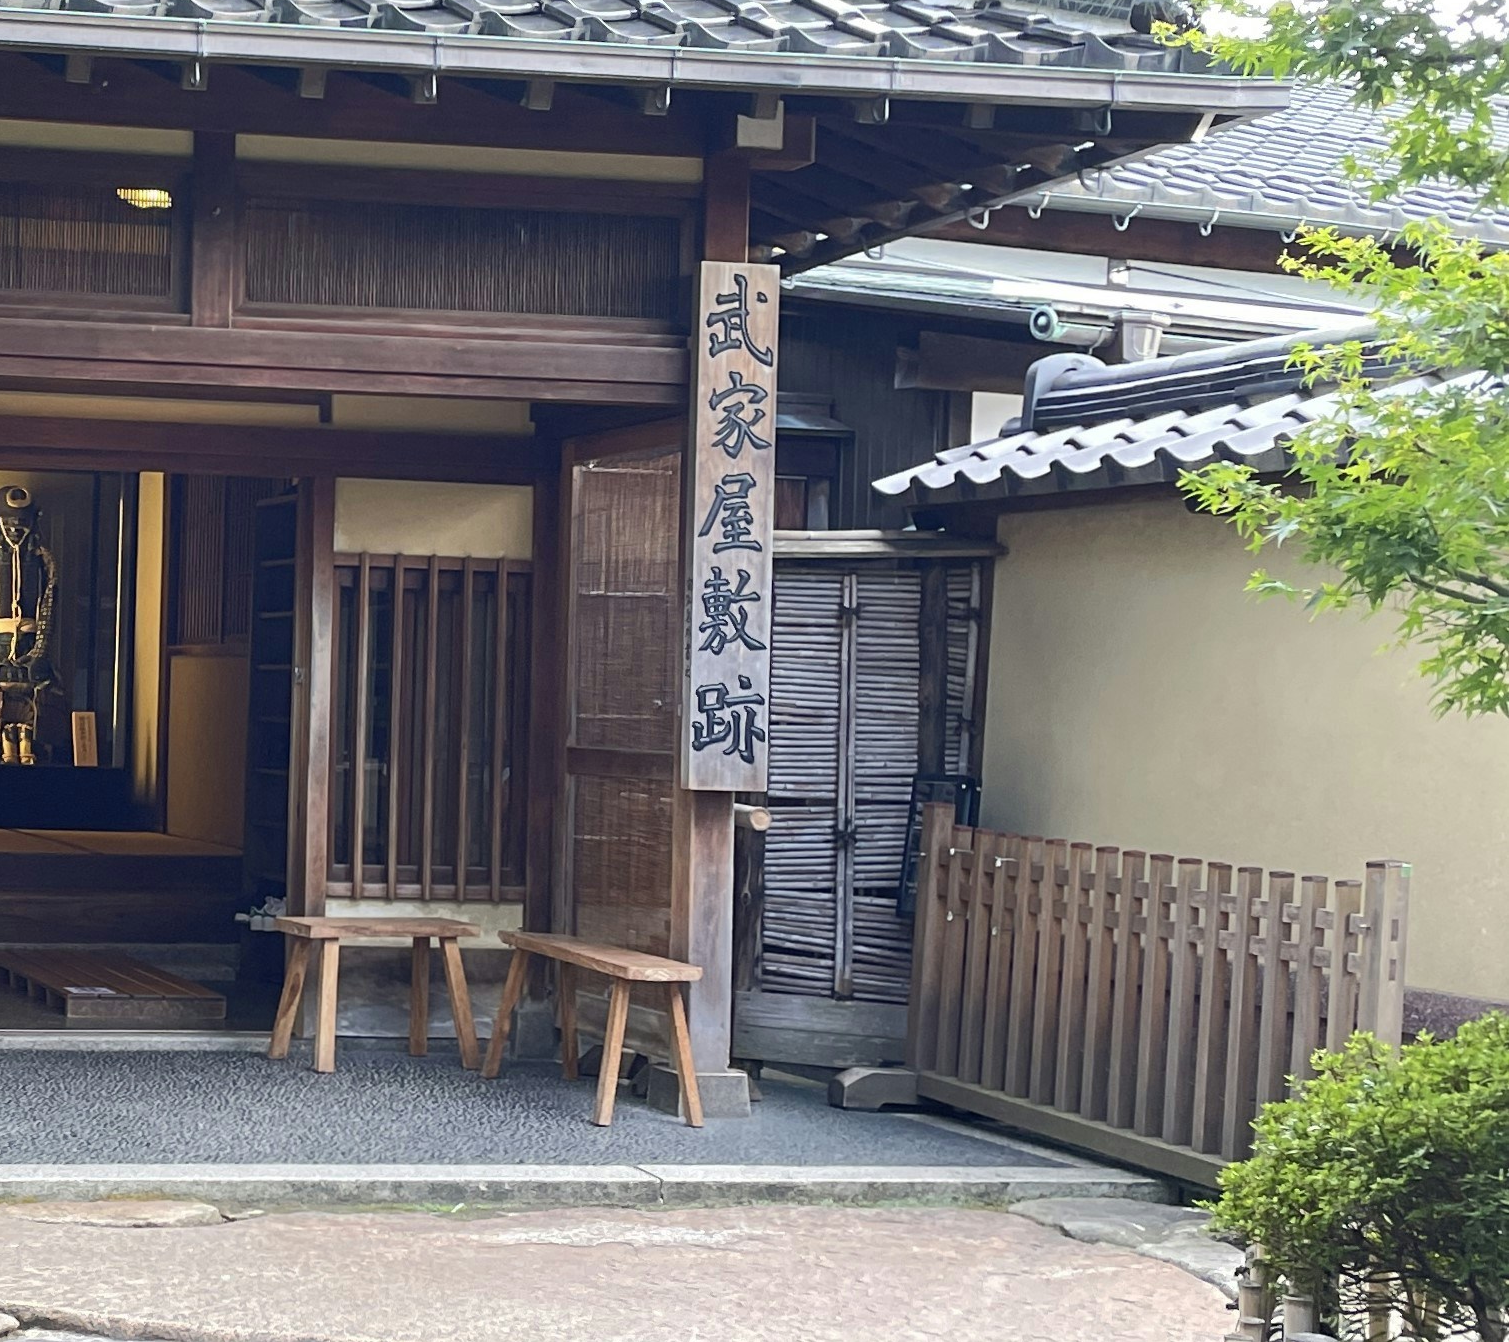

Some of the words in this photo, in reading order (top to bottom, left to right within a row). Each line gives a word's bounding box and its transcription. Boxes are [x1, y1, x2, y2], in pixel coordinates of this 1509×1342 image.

[691, 273, 774, 764] 武家屋敷跡
